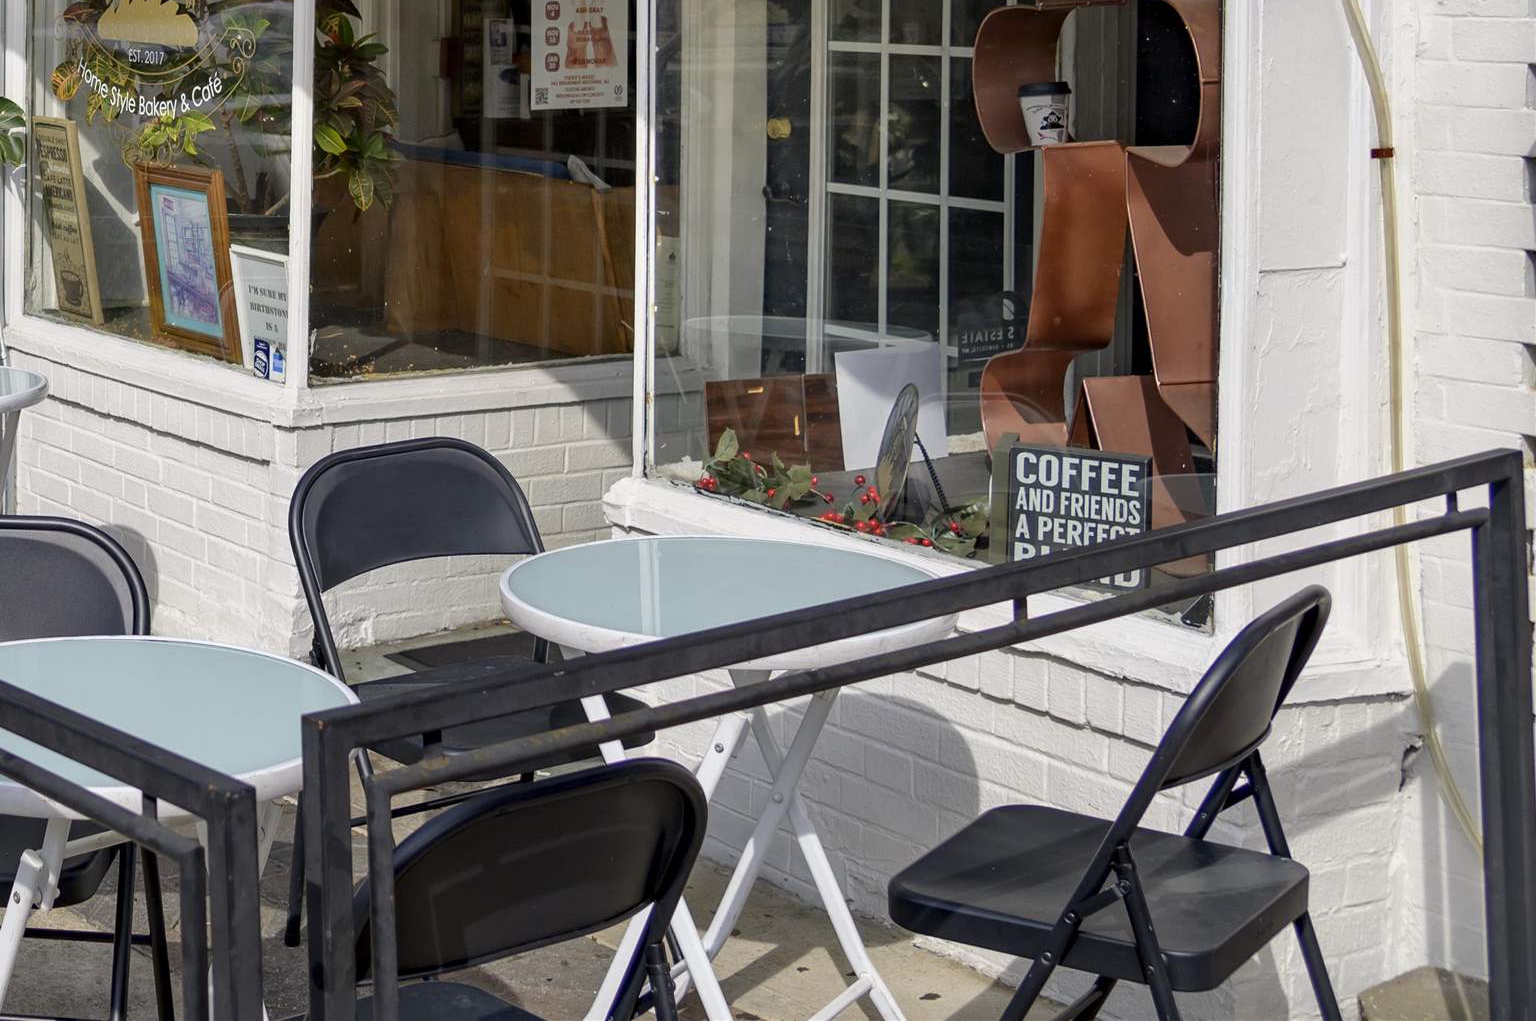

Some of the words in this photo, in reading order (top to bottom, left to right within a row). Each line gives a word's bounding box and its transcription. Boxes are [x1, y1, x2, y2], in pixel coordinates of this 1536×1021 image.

[77, 56, 109, 98] Home
[110, 86, 136, 114] Style
[138, 95, 177, 120] Bakery
[180, 93, 190, 113] &
[191, 71, 223, 107] Café
[259, 287, 277, 299] SURE
[278, 291, 287, 302] MY
[1016, 451, 1140, 497] COFFEE
[1015, 486, 1054, 513] AND
[1060, 492, 1141, 524] FRIENDS
[1015, 513, 1030, 539] A
